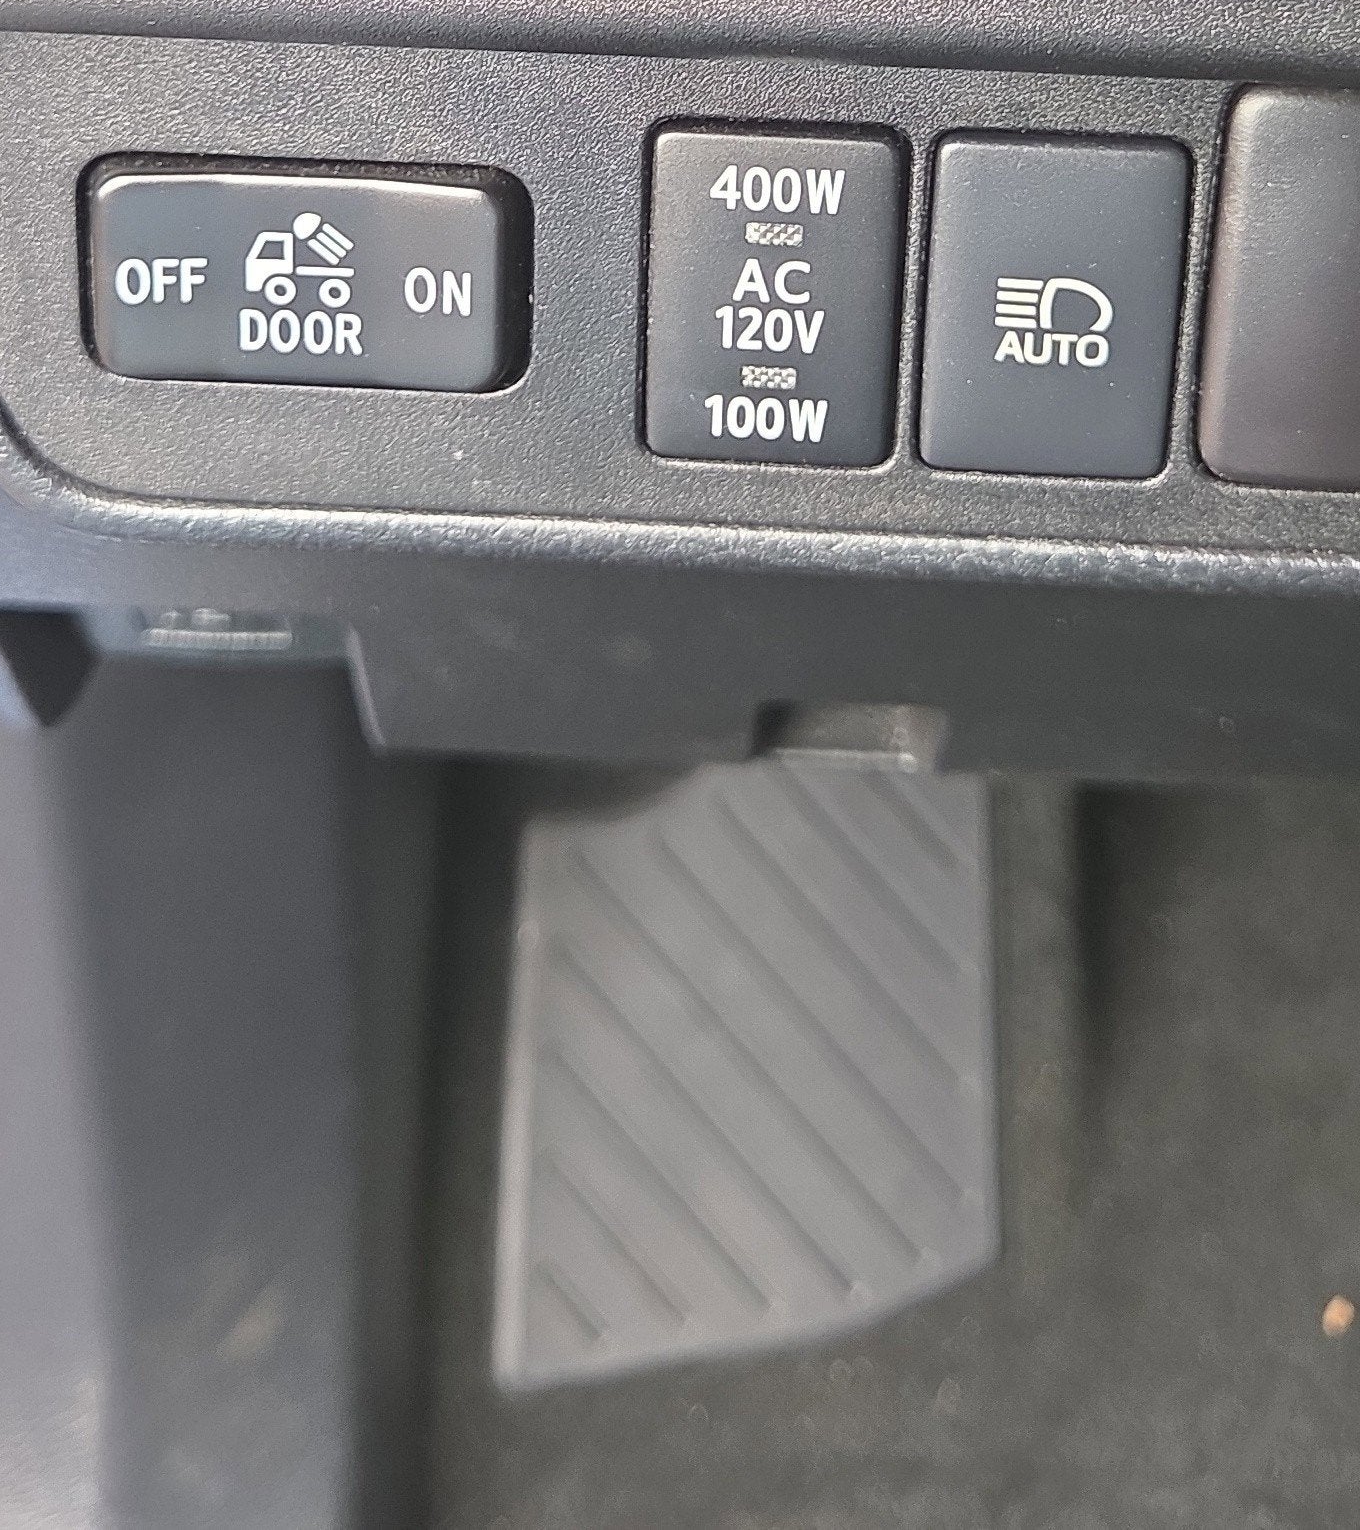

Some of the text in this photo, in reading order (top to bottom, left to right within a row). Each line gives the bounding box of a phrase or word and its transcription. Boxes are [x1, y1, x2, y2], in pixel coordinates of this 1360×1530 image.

[708, 164, 846, 216] 400W
[114, 257, 208, 306] OFF
[402, 266, 472, 317] ON
[731, 258, 812, 305] AC
[238, 308, 364, 357] DOOR
[714, 304, 826, 355] 120V
[992, 331, 1111, 369] AUTO
[703, 394, 829, 444] 100W
